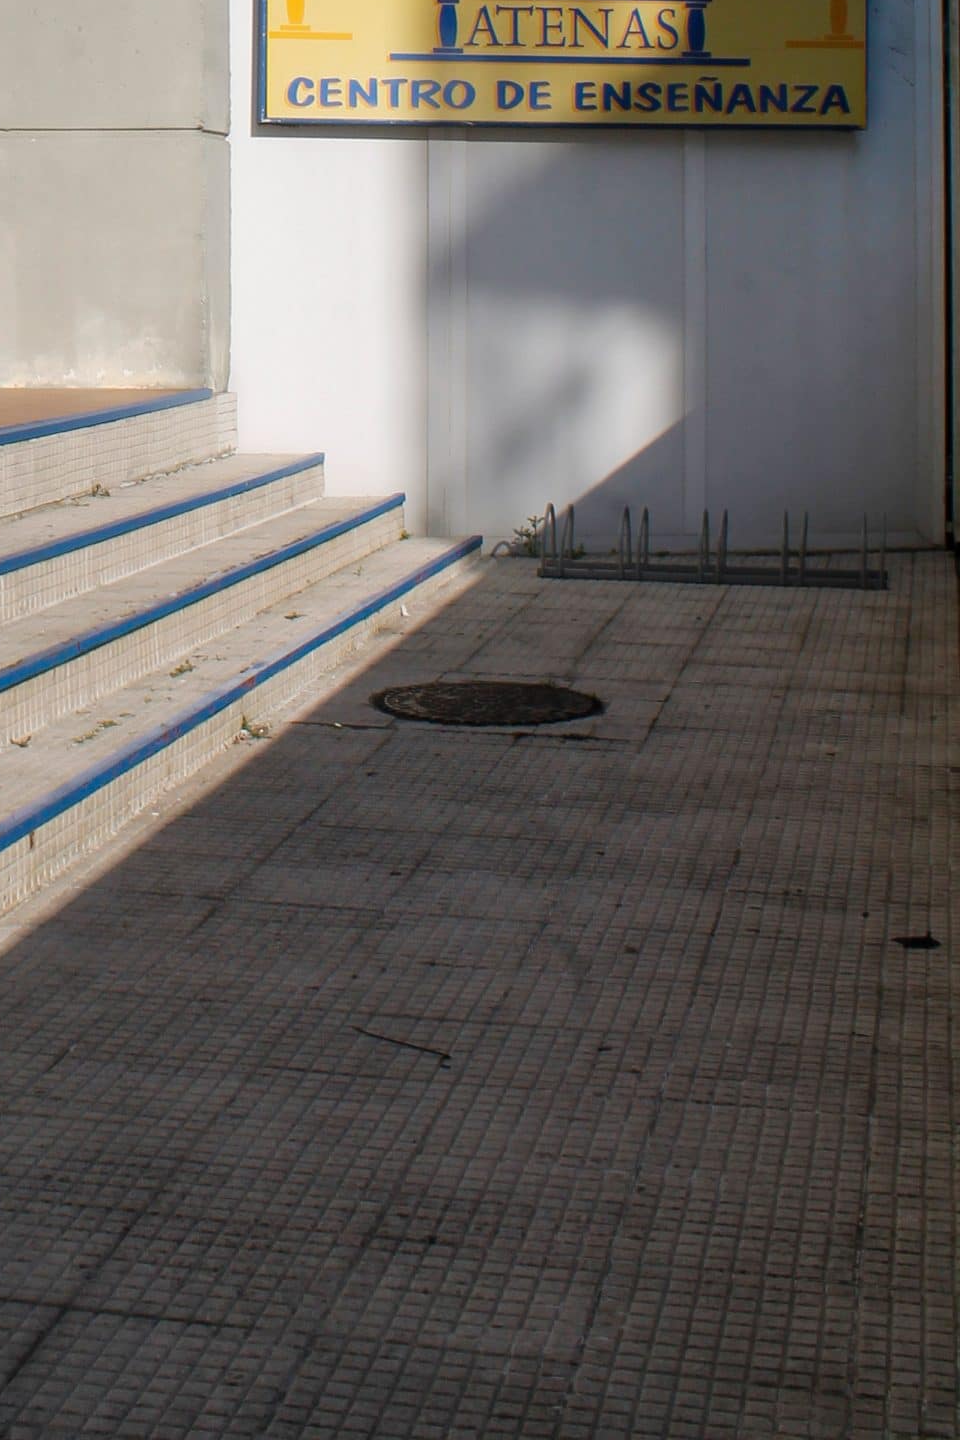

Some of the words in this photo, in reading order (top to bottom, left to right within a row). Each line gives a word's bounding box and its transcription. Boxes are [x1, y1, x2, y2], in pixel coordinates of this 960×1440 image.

[464, 5, 680, 50] ATENAS
[286, 76, 476, 110] CENTRO
[497, 80, 552, 111] DE
[573, 76, 851, 116] ENSEÑANZA
